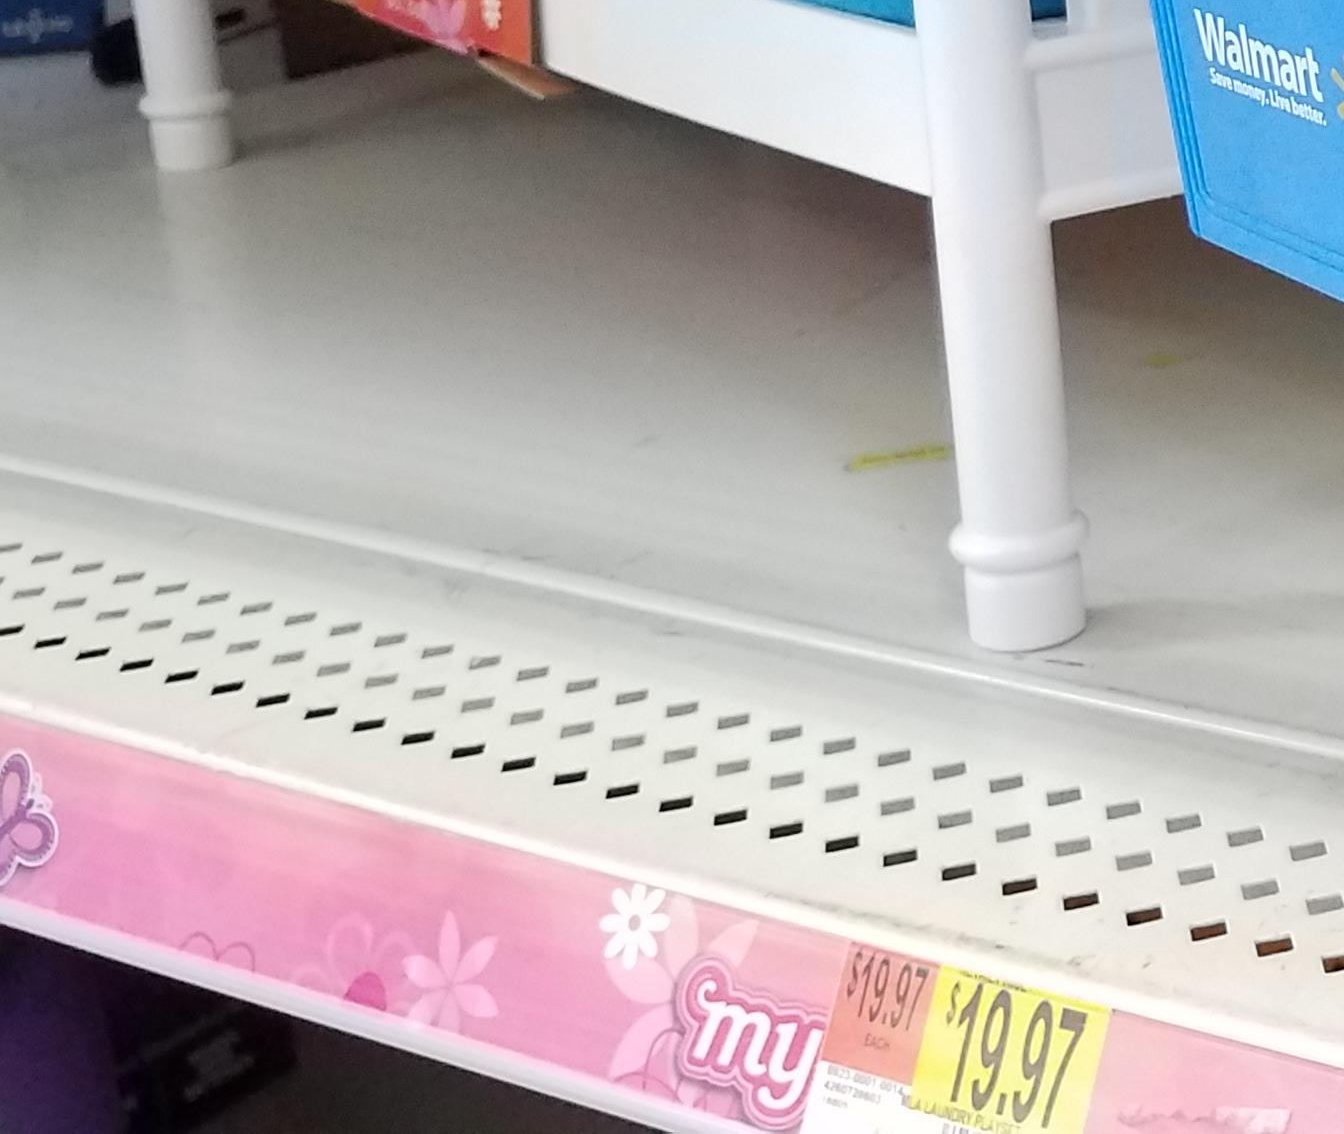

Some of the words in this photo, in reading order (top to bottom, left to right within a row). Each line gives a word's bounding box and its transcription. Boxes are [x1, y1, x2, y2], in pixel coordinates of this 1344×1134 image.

[1193, 7, 1324, 103] Walmart
[1209, 67, 1234, 91] Save
[1233, 81, 1270, 107] money.
[1270, 89, 1293, 112] Live
[1293, 99, 1327, 127] better.
[847, 951, 929, 1032] $19.97
[692, 979, 824, 1110] my
[946, 981, 1089, 1129] $19.97
